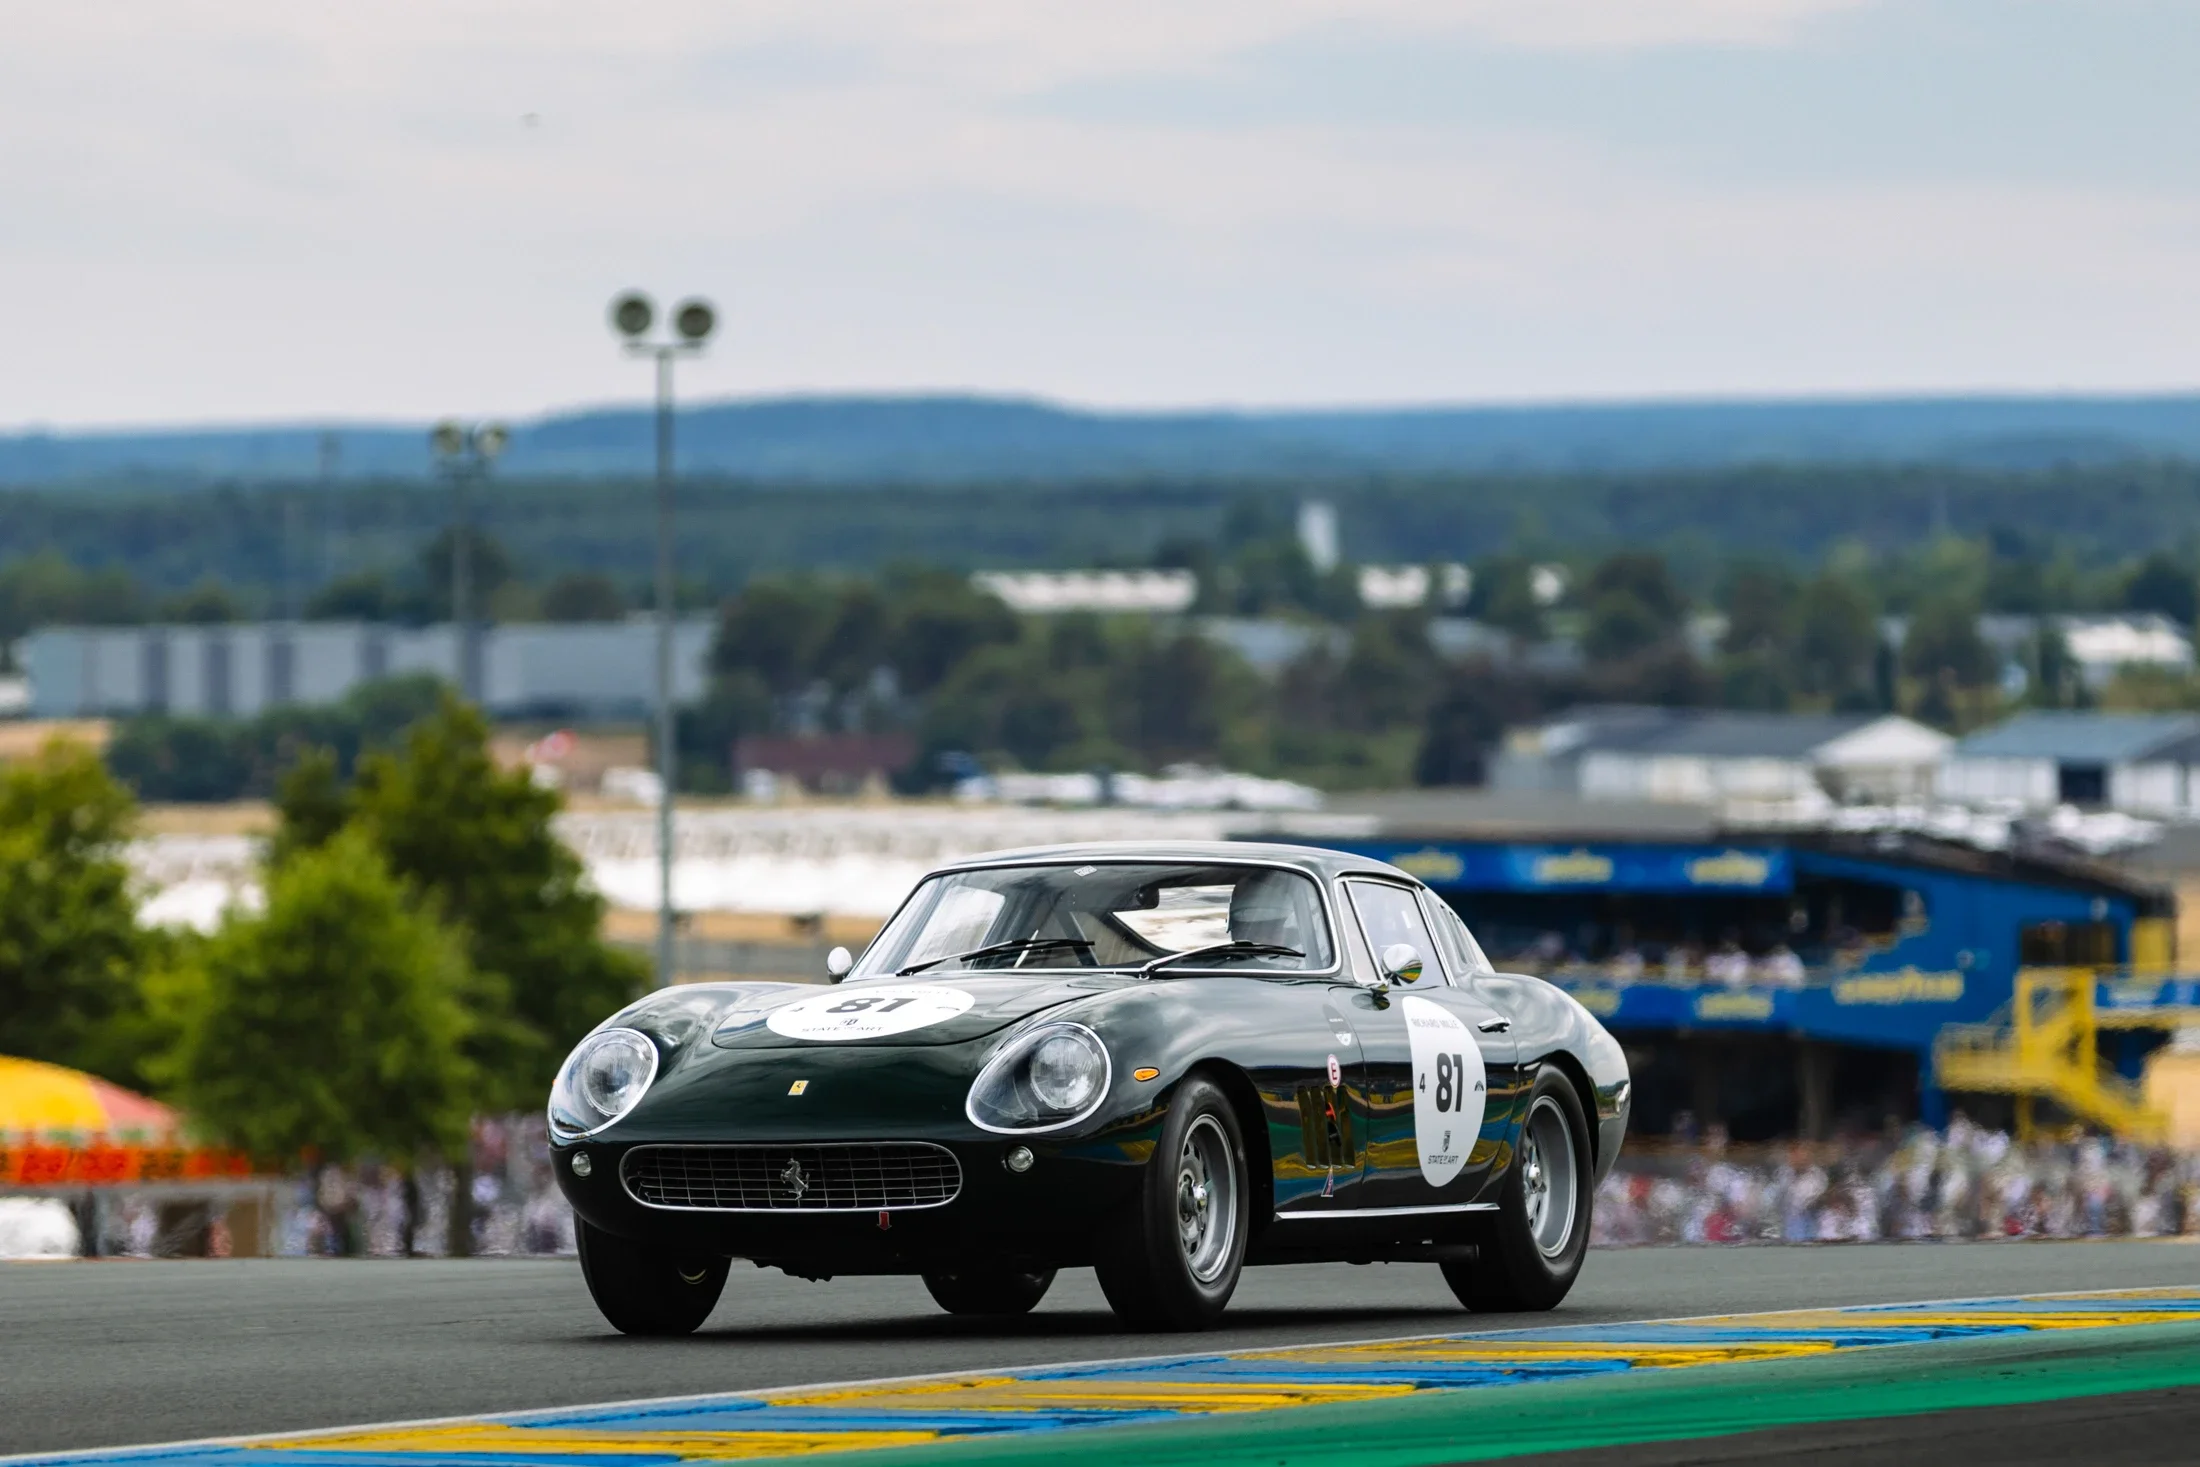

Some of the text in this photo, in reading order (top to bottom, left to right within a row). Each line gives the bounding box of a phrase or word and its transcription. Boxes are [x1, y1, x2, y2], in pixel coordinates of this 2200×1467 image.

[826, 997, 917, 1013] 81
[1331, 1062, 1338, 1081] E
[1419, 1073, 1426, 1093] 4
[1436, 1052, 1464, 1113] 81
[1428, 1155, 1443, 1164] STATE
[1448, 1155, 1459, 1164] ART
